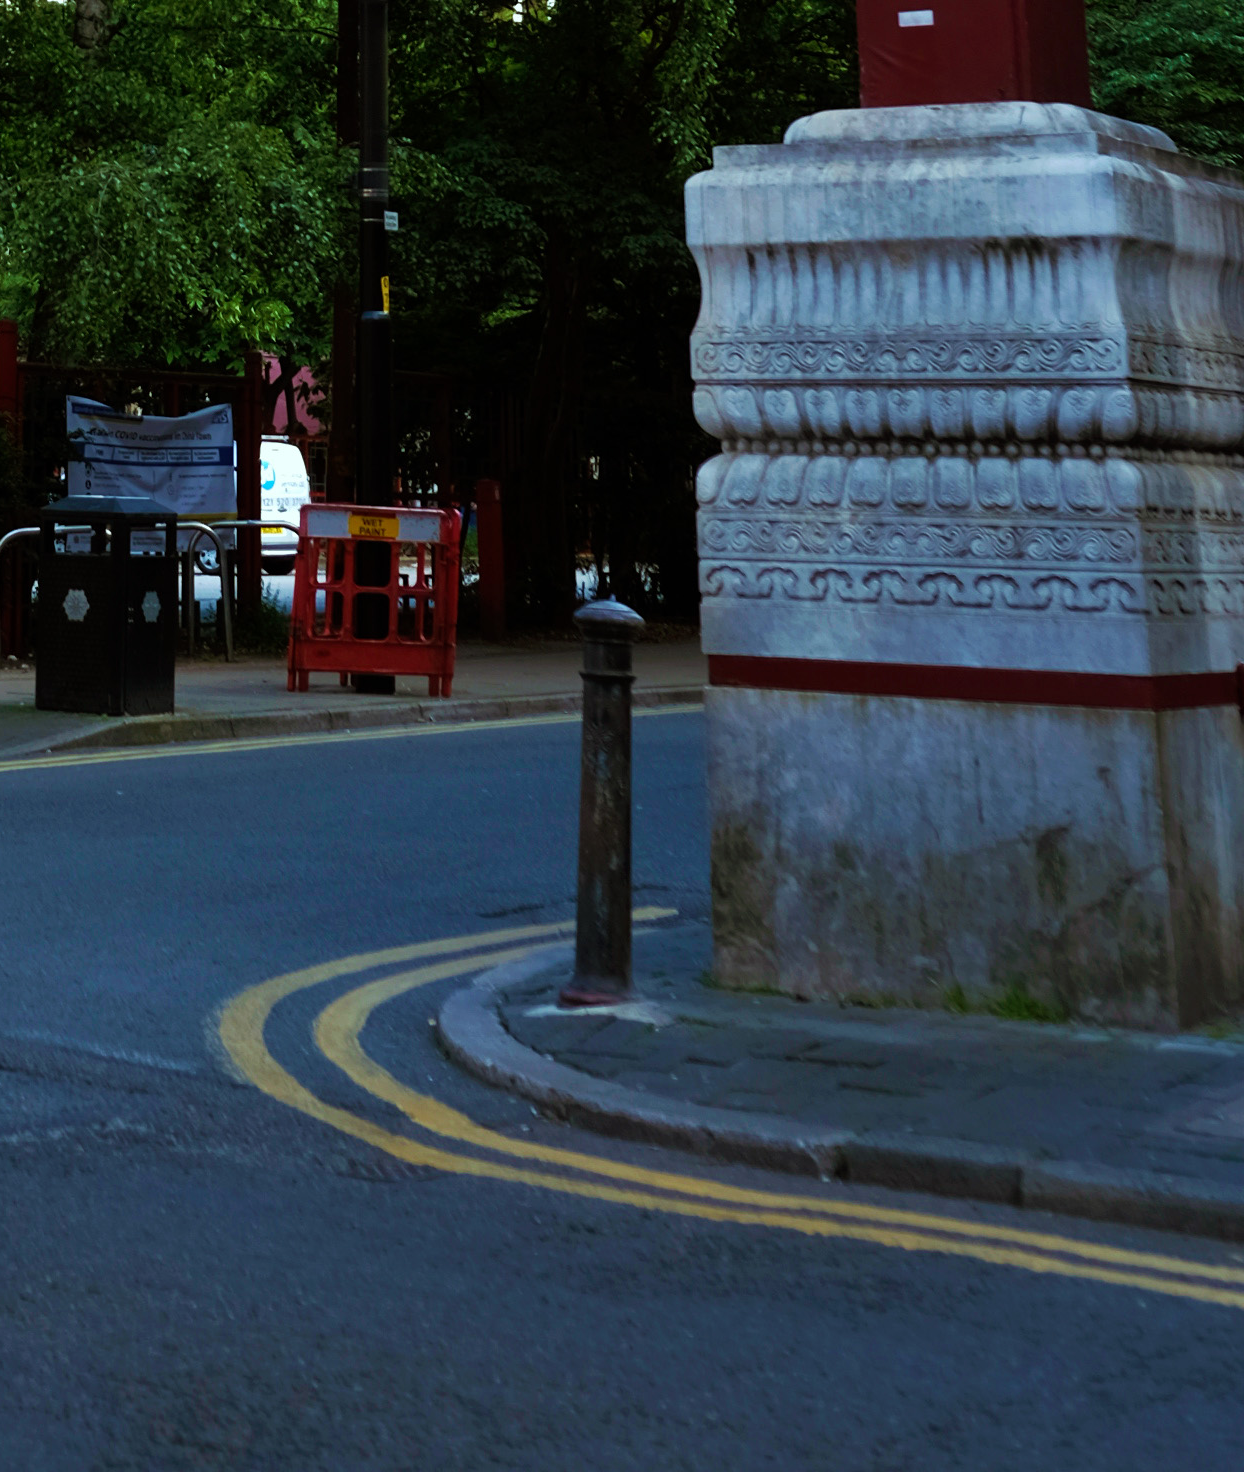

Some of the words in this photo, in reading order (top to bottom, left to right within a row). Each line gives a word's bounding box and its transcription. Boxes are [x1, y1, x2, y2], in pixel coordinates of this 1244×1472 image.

[115, 430, 138, 441] COVID
[361, 518, 384, 527] WET
[360, 527, 387, 536] PAINT
